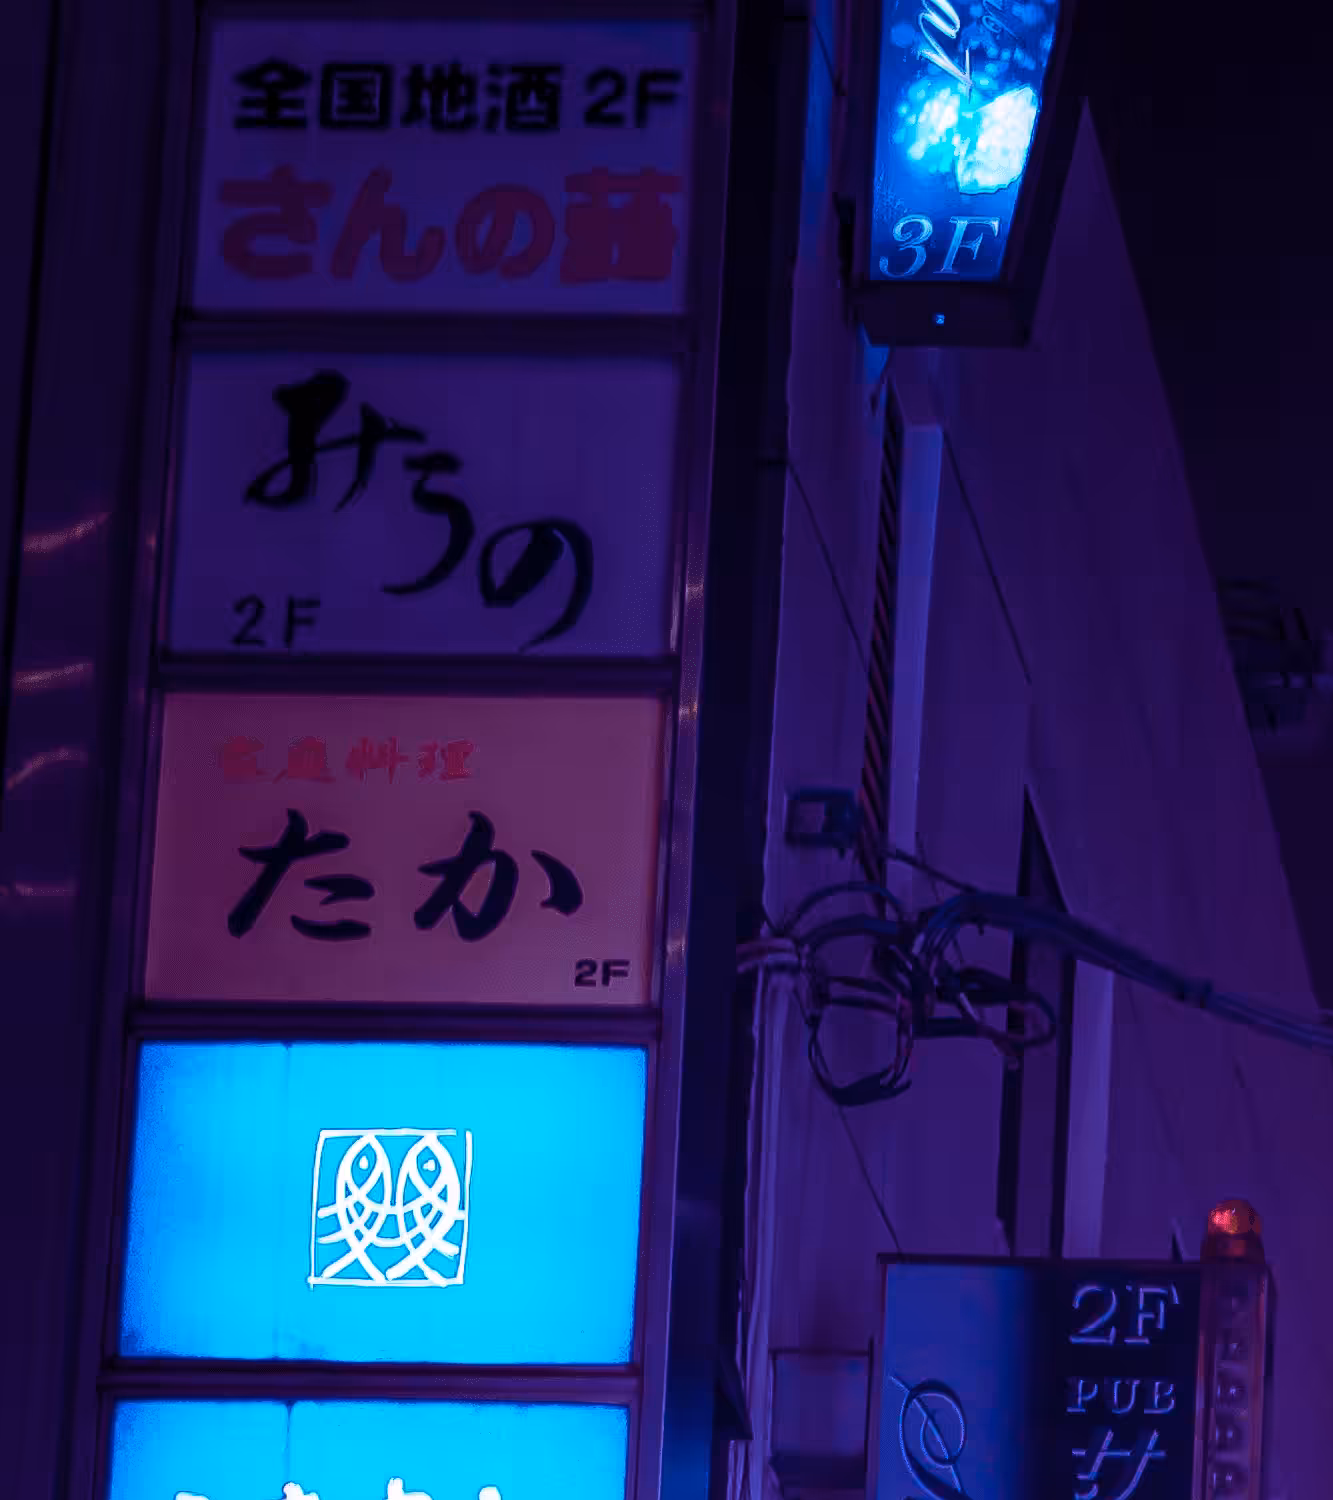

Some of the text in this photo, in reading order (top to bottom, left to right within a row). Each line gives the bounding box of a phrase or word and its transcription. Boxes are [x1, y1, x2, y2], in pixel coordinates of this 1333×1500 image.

[234, 61, 684, 133] 全国地酒 2F
[879, 213, 1001, 279] 3F
[231, 598, 321, 648] 2F
[227, 808, 583, 942] たか
[573, 959, 631, 988] 2F
[1067, 1285, 1181, 1348] 2F
[1065, 1377, 1178, 1415] PUB
